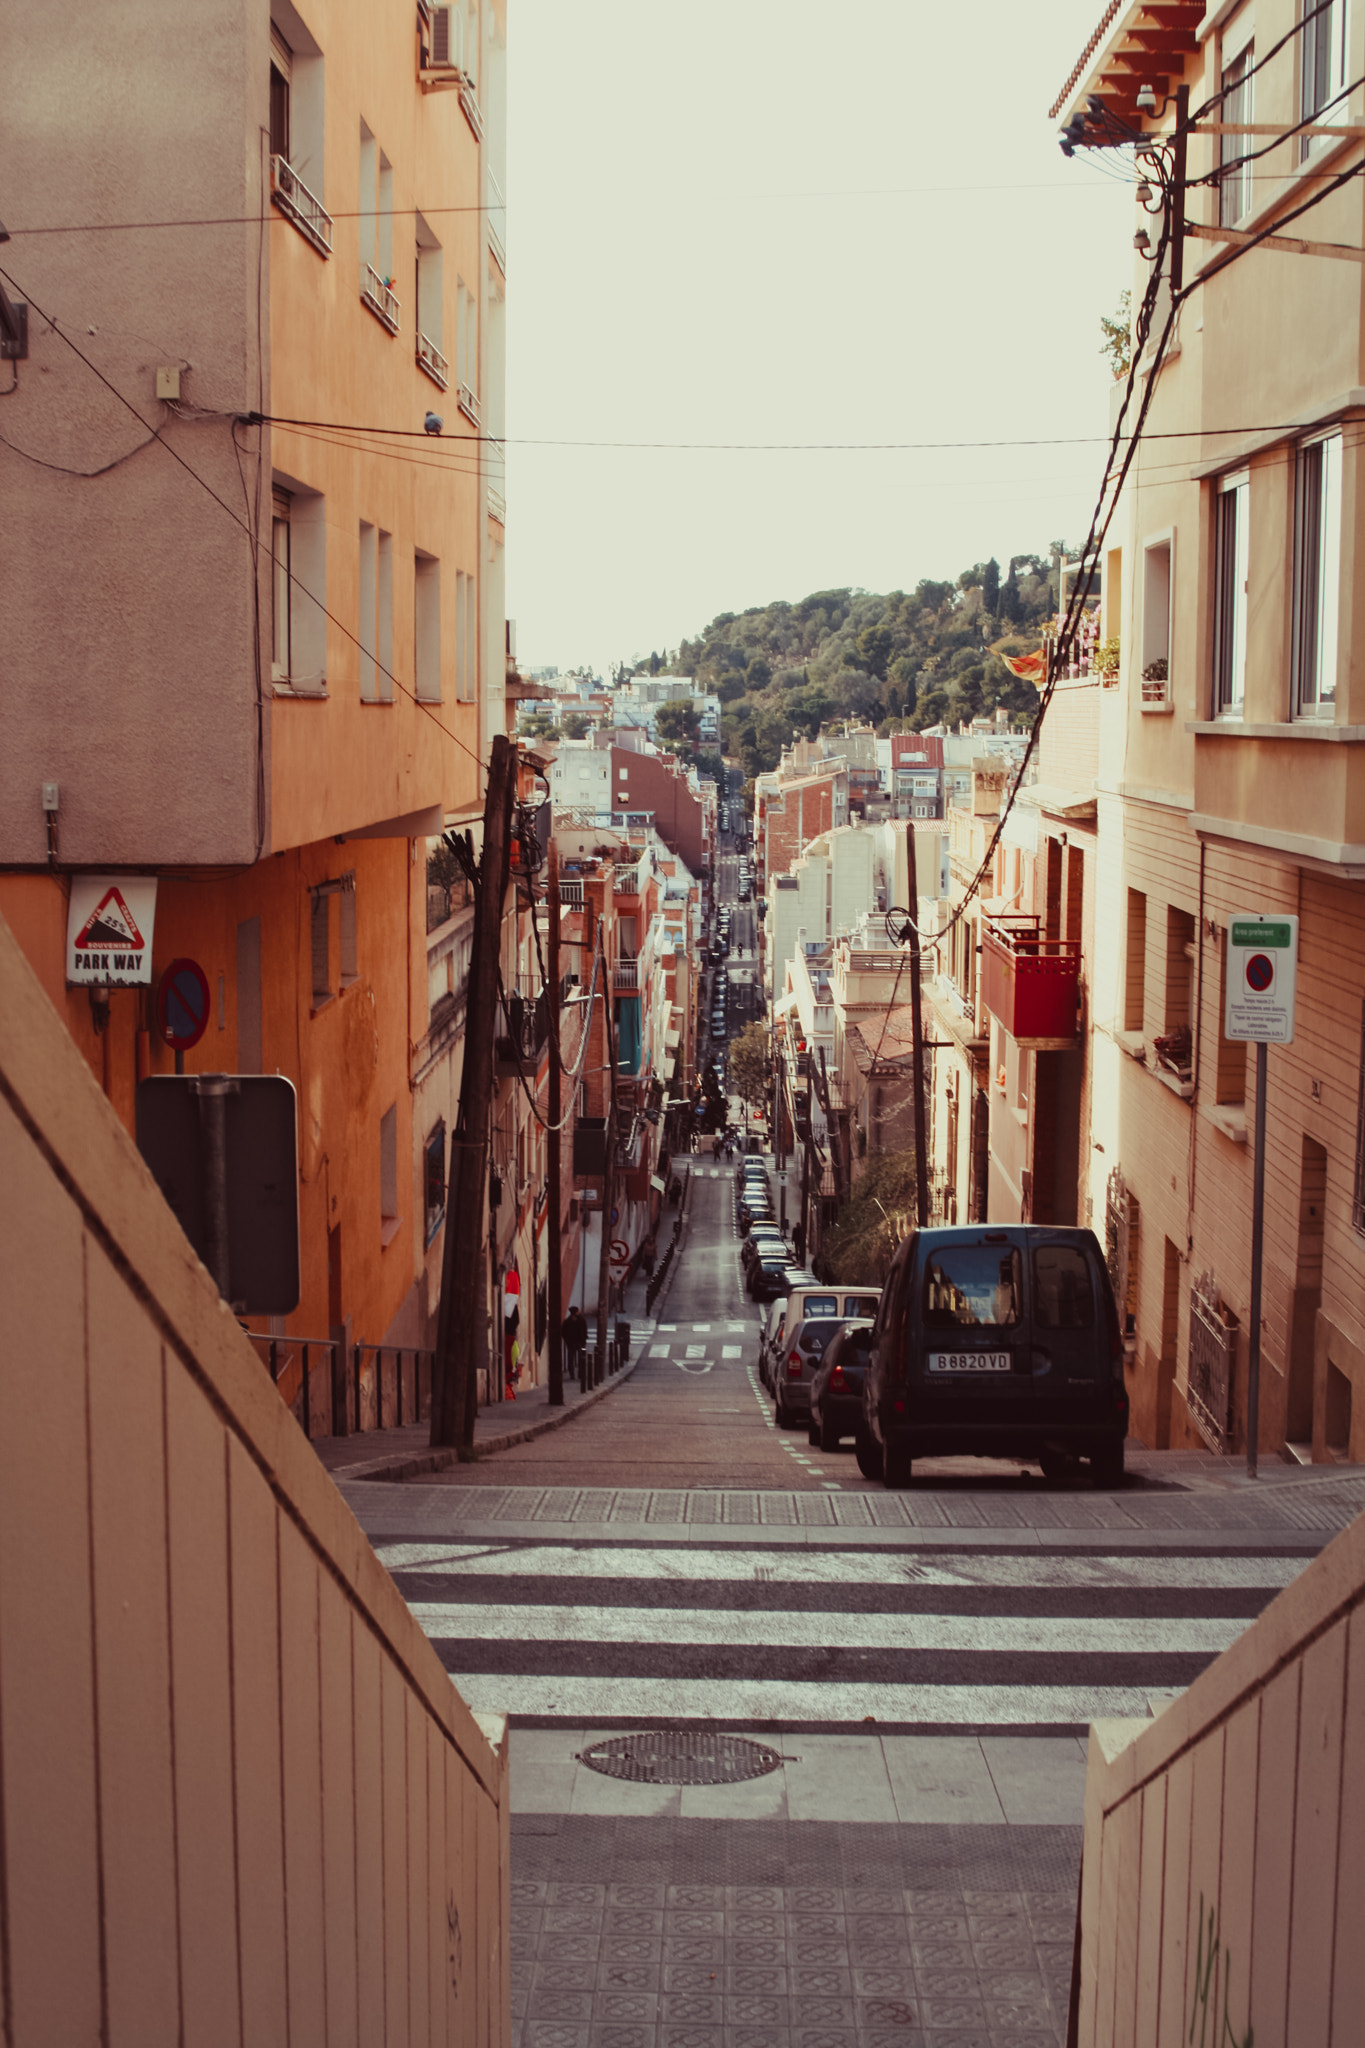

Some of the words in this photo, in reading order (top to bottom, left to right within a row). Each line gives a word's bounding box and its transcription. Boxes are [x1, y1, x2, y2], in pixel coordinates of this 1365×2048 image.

[86, 908, 103, 929] GIFTS
[104, 915, 127, 934] 25%
[120, 904, 138, 933] CRAFTS
[87, 942, 132, 950] SOUVENIRS
[75, 953, 109, 970] PARK
[114, 953, 143, 970] WAY
